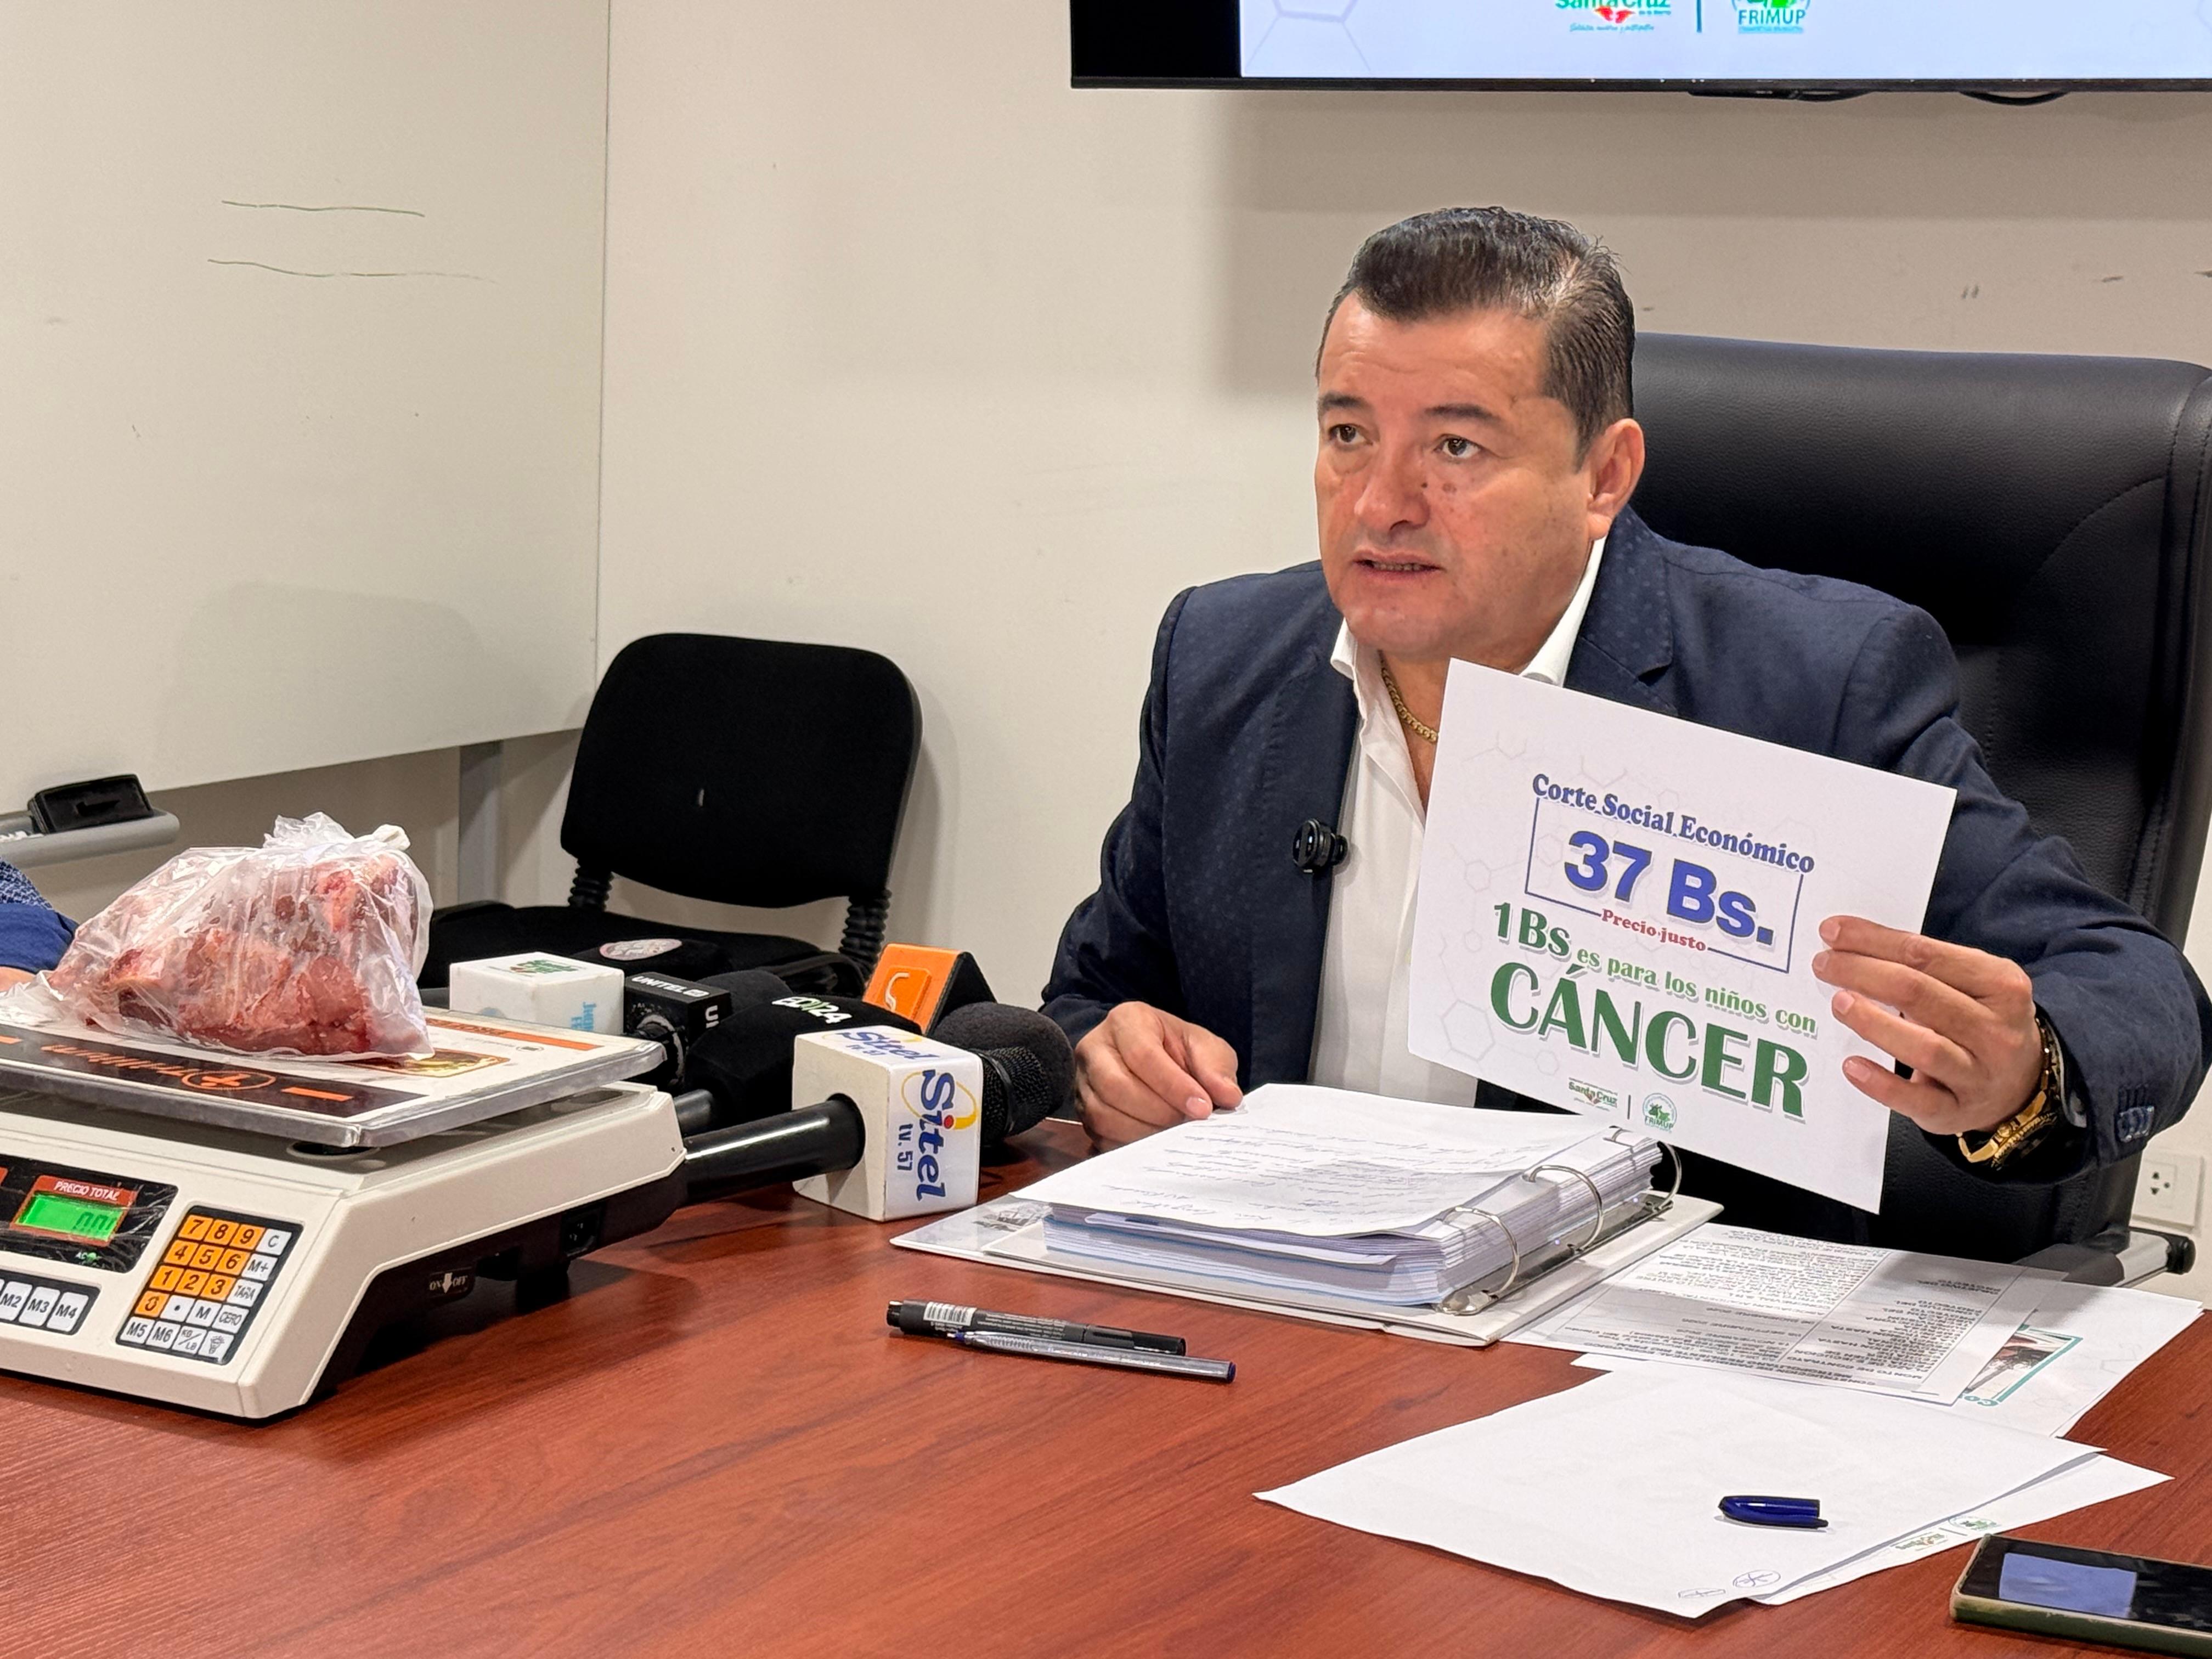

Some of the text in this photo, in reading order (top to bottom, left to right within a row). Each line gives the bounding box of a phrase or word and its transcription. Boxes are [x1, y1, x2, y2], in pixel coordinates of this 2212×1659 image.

[1739, 9, 1806, 25] FRIMUP
[1533, 774, 1814, 873] Corte Social Económico
[1565, 831, 1774, 945] 37 Bs.
[1602, 910, 1706, 951] Precio justo
[631, 975, 686, 993] UNITEL
[1577, 949, 1600, 970] es
[1608, 958, 1657, 986] para
[1666, 970, 1697, 996] los
[1705, 988, 1767, 1016] niños
[1776, 1008, 1816, 1032] con
[835, 1031, 940, 1059] Sitel
[1491, 962, 1808, 1117] CÁNCER
[1568, 1081, 1595, 1097] Santa
[1596, 1091, 1618, 1104] Cruz
[1645, 1115, 1674, 1130] FRIMUP
[917, 1069, 955, 1201] Sitel
[897, 1150, 913, 1171] 57
[53, 1180, 121, 1201] PRECIO TOTAL
[191, 1220, 204, 1234] 7
[214, 1224, 229, 1236] 8
[240, 1229, 255, 1244] 9
[268, 1235, 279, 1248] C
[174, 1245, 188, 1261] 4
[199, 1249, 215, 1265] 5
[225, 1254, 241, 1269] 6
[247, 1259, 269, 1273] M+
[162, 1270, 173, 1285] 1
[184, 1274, 199, 1290] 2
[211, 1279, 225, 1295] 3
[0, 1293, 22, 1308] M2
[27, 1298, 50, 1313] M3
[145, 1296, 160, 1312] 0
[55, 1304, 78, 1319] M4
[196, 1306, 211, 1320] M
[127, 1323, 148, 1338] M5
[152, 1327, 173, 1342] M6
